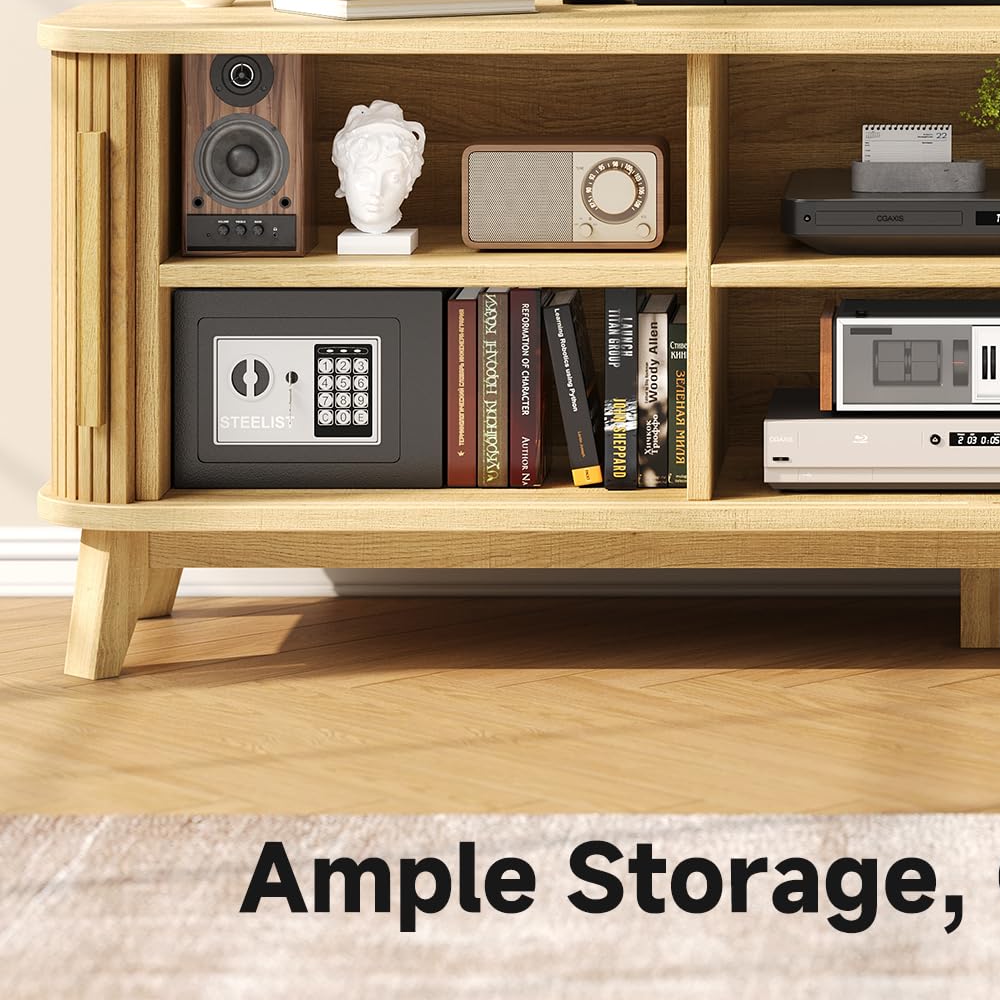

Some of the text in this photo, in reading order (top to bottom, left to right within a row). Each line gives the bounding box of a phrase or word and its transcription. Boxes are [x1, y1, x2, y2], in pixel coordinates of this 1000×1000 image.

[521, 303, 530, 416] REFORMATION OF CHARACTER
[554, 308, 578, 412] Learning Robotics using Python
[608, 308, 621, 368] TITAN GROUP
[620, 317, 633, 357] LAUNCH
[648, 321, 660, 403] Woody Allen
[220, 415, 295, 429] STEELIST
[675, 370, 686, 425] ЗЕЛЕНАЯ
[612, 398, 627, 478] JOHN SHEPPARD
[675, 429, 686, 464] МИЛЯ
[967, 436, 978, 445] 03
